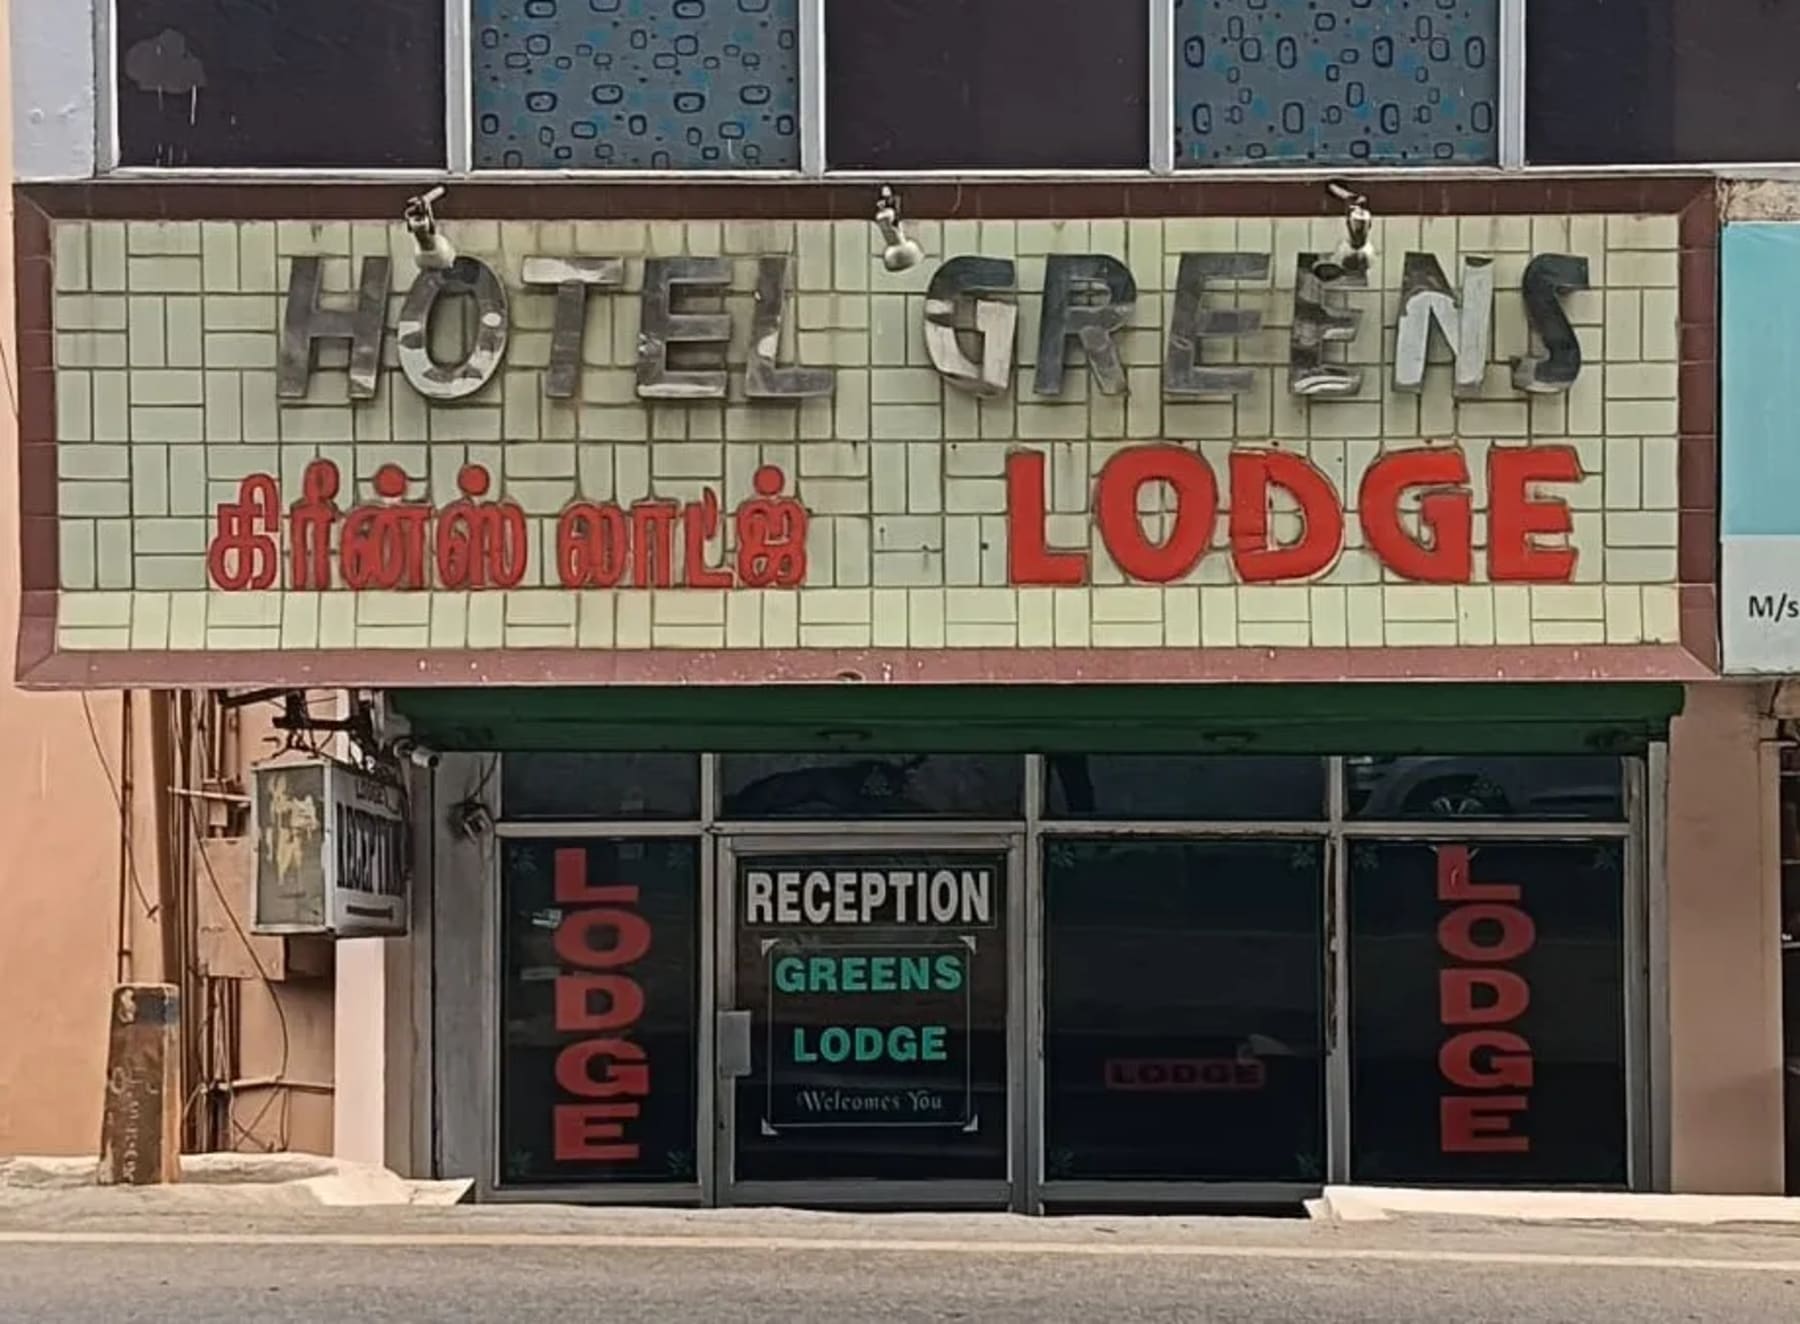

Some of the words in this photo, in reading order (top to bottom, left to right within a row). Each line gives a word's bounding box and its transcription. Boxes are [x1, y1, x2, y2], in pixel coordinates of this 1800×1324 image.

[276, 254, 836, 400] HOTEL
[923, 250, 1591, 399] GREENS
[1005, 442, 1588, 586] LODGE
[747, 869, 991, 924] RECEPTION
[774, 954, 964, 993] GREENS
[1436, 844, 1537, 1152] LODGE
[553, 847, 652, 1161] LODGE
[793, 1025, 949, 1063] LODGE
[796, 1088, 901, 1113] Welcomes
[906, 1089, 943, 1112] You
[1110, 1062, 1261, 1085] LODGE
